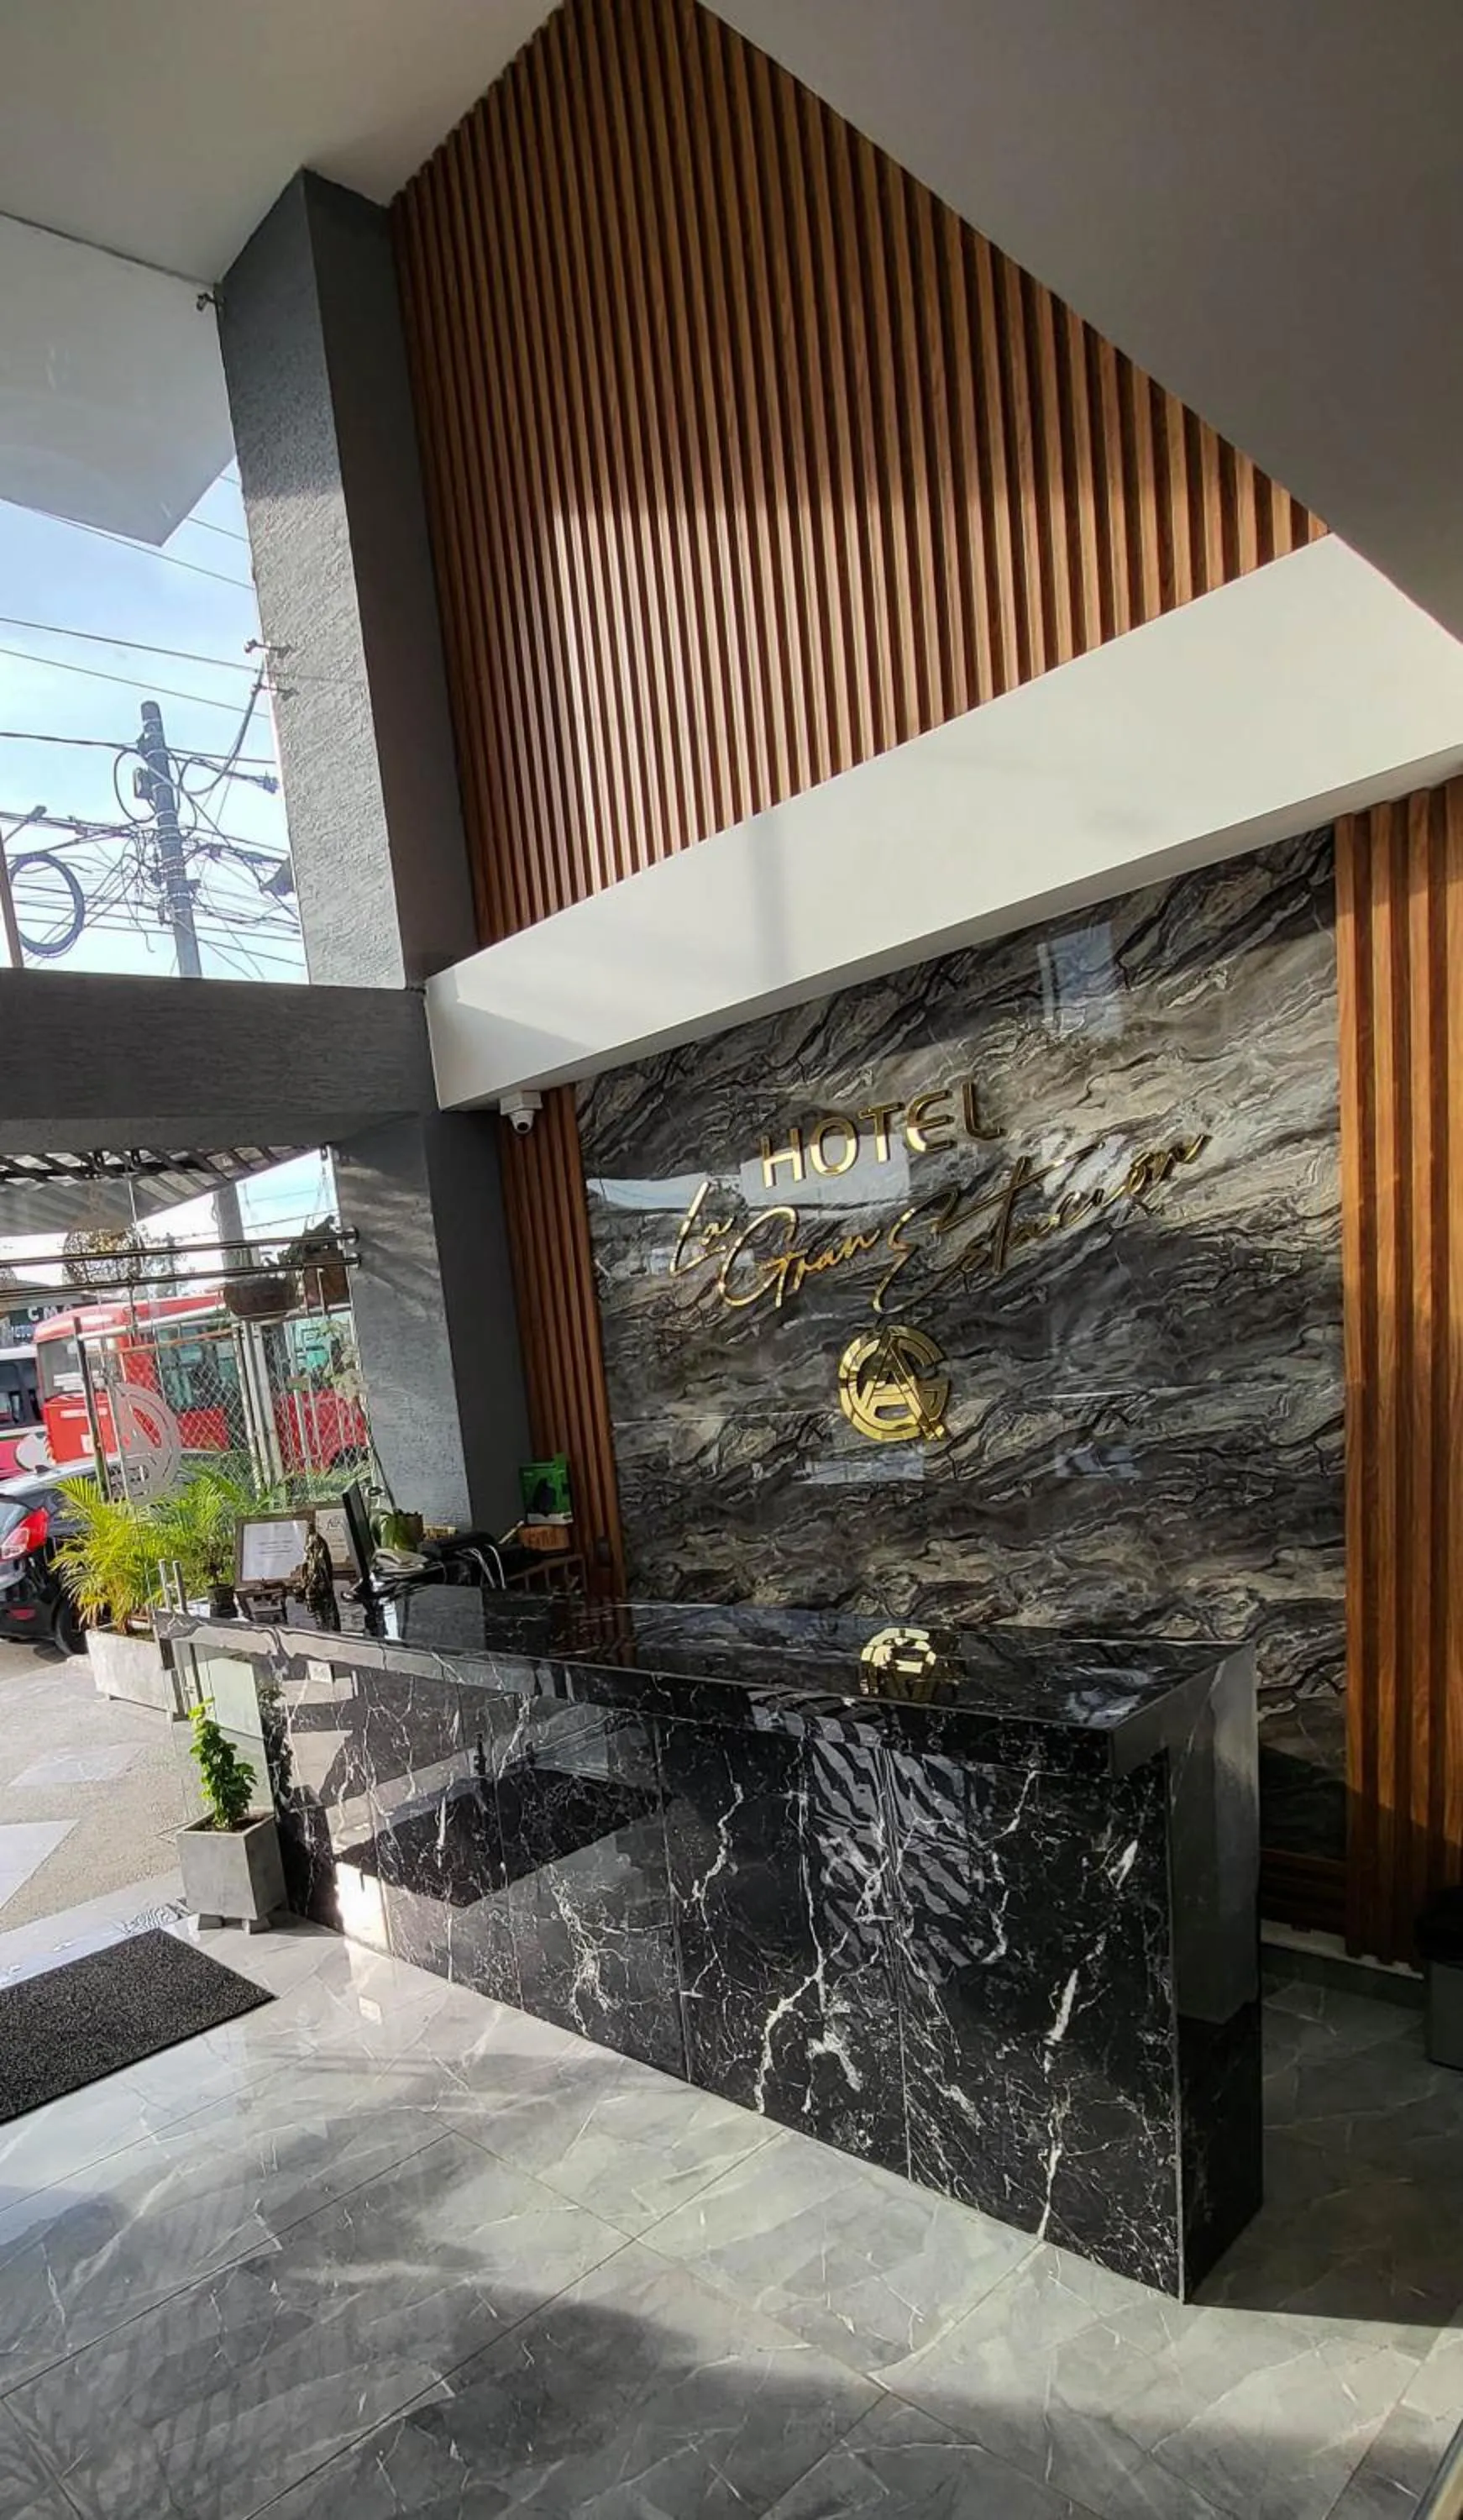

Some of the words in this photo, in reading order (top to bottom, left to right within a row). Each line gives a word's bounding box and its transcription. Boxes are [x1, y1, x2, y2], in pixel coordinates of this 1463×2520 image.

[760, 1083, 1004, 1189] HOTEL
[669, 1180, 734, 1278] La
[719, 1206, 880, 1308] Gran
